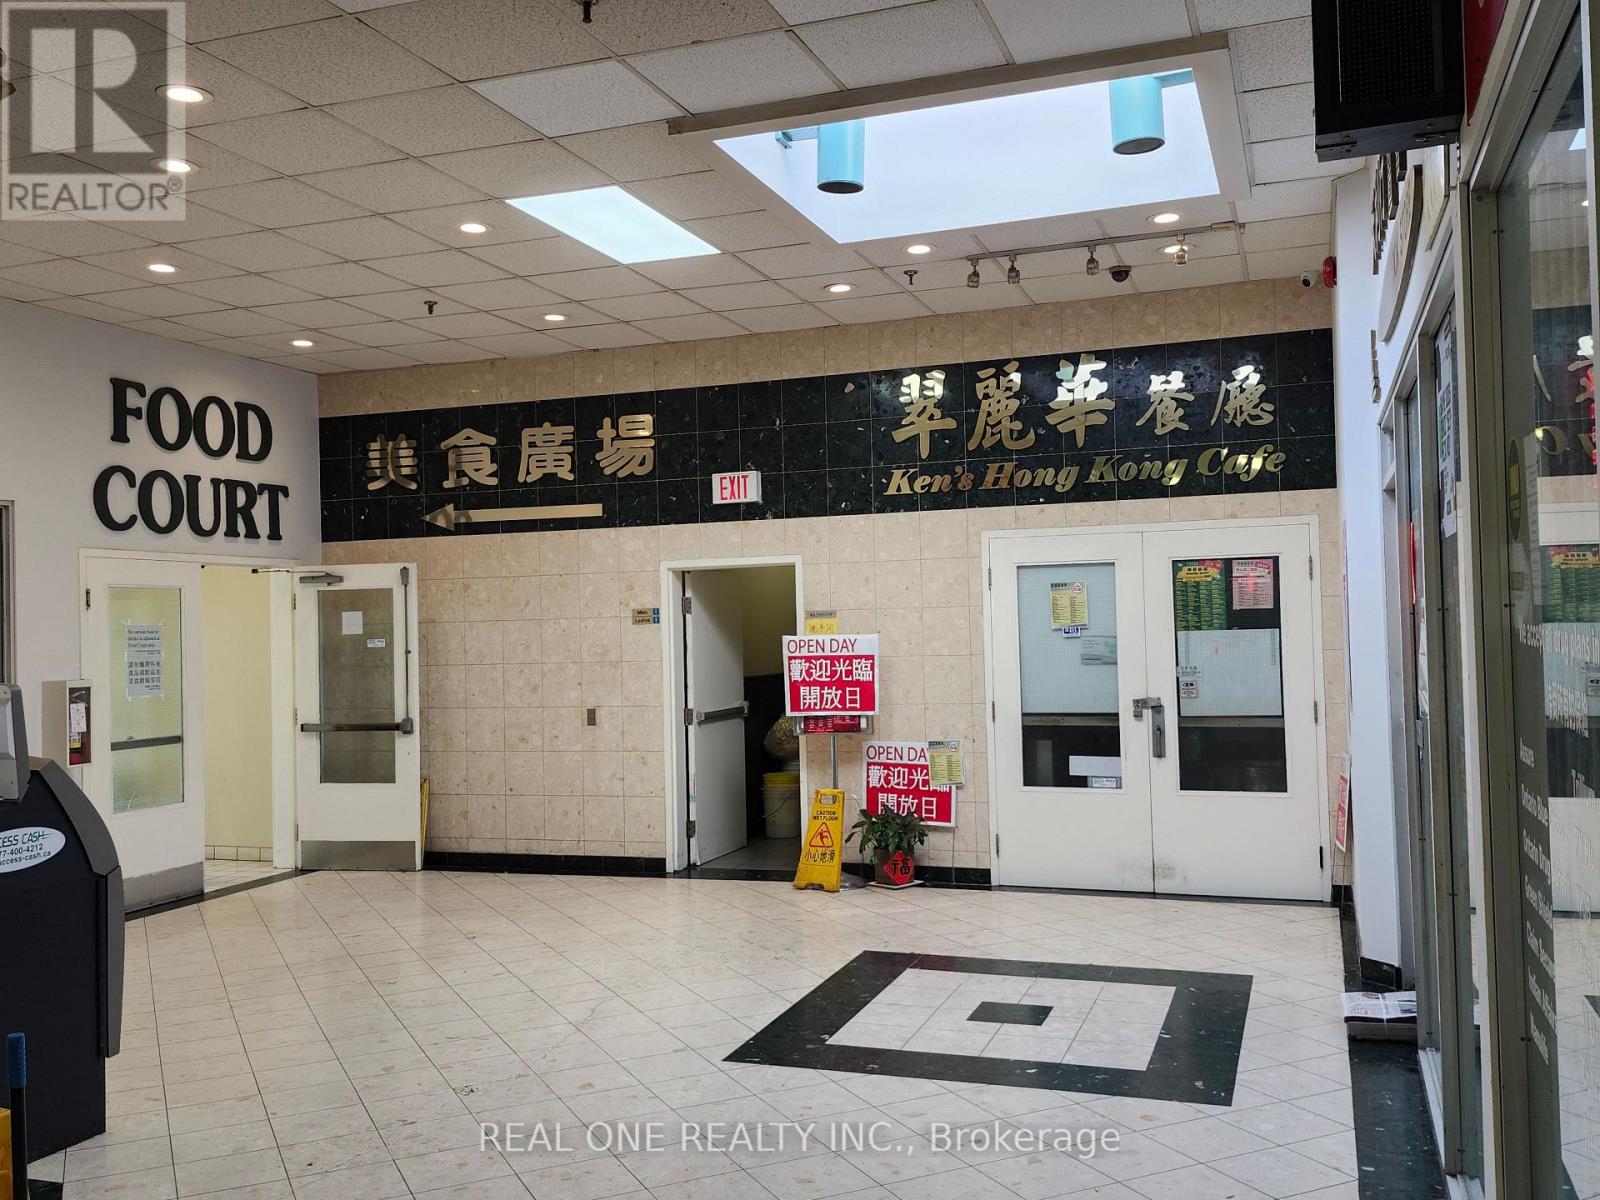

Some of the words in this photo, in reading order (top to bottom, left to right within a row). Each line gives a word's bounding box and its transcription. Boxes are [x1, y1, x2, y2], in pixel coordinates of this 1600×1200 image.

[109, 377, 273, 461] FOOD
[891, 353, 1276, 460] 翠麗華餐廳
[366, 413, 656, 492] 美食廣場
[883, 464, 974, 497] Ken's
[978, 461, 1080, 494] Hong
[1084, 453, 1188, 488] Kong
[1196, 446, 1288, 482] Cafe
[719, 474, 750, 502] EXIT
[92, 464, 290, 541] COURT
[787, 638, 826, 654] OPEN
[829, 638, 857, 653] DAY
[789, 658, 873, 682] 歡迎光臨
[800, 686, 861, 710] 開放日
[866, 745, 904, 762] OPEN
[907, 747, 929, 763] DA
[22, 830, 46, 844] CASH
[891, 857, 911, 876] 福
